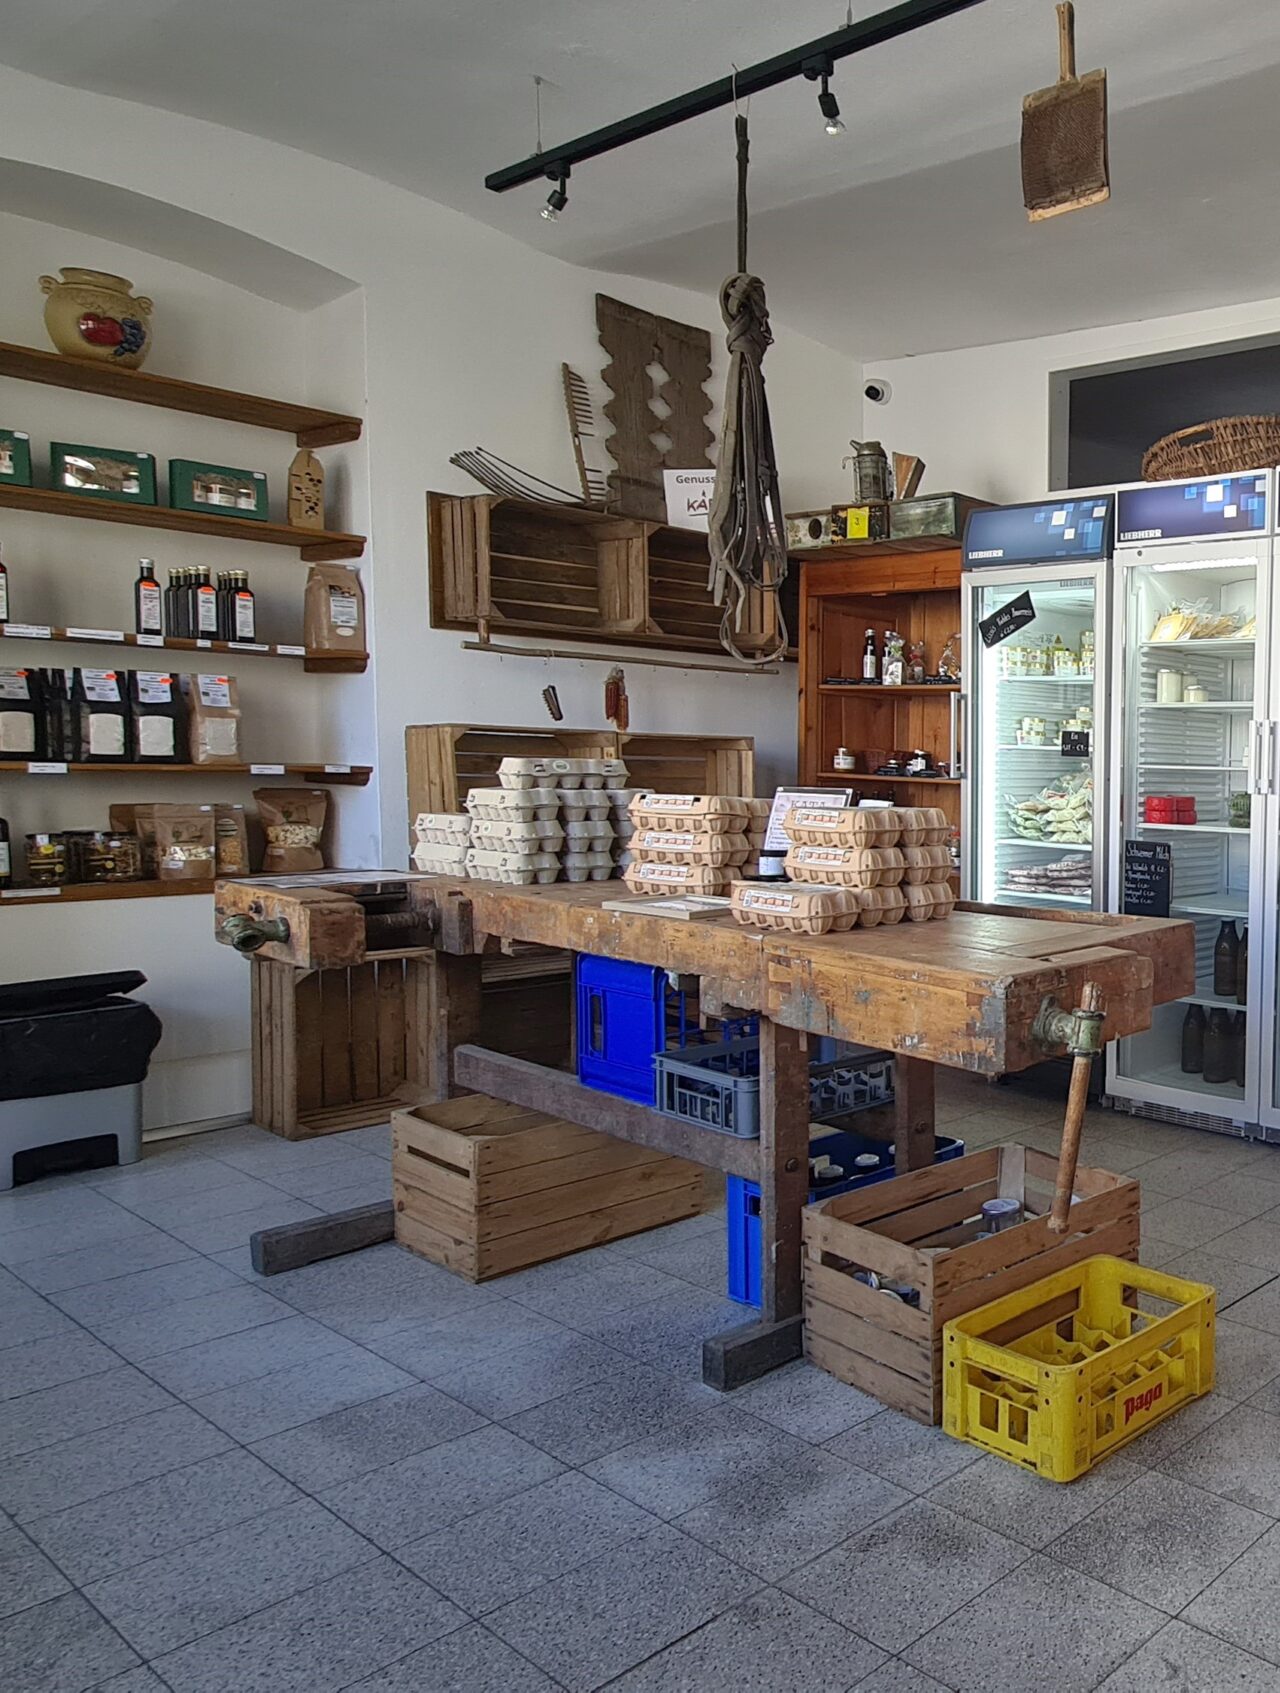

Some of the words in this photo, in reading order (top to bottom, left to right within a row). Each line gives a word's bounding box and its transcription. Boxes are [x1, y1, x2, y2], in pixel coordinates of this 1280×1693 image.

[1120, 528, 1162, 541] LIEBHERR
[968, 549, 1004, 560] LIEBHERR
[1059, 578, 1094, 588] LIEBHERR
[1123, 1381, 1163, 1426] pago
